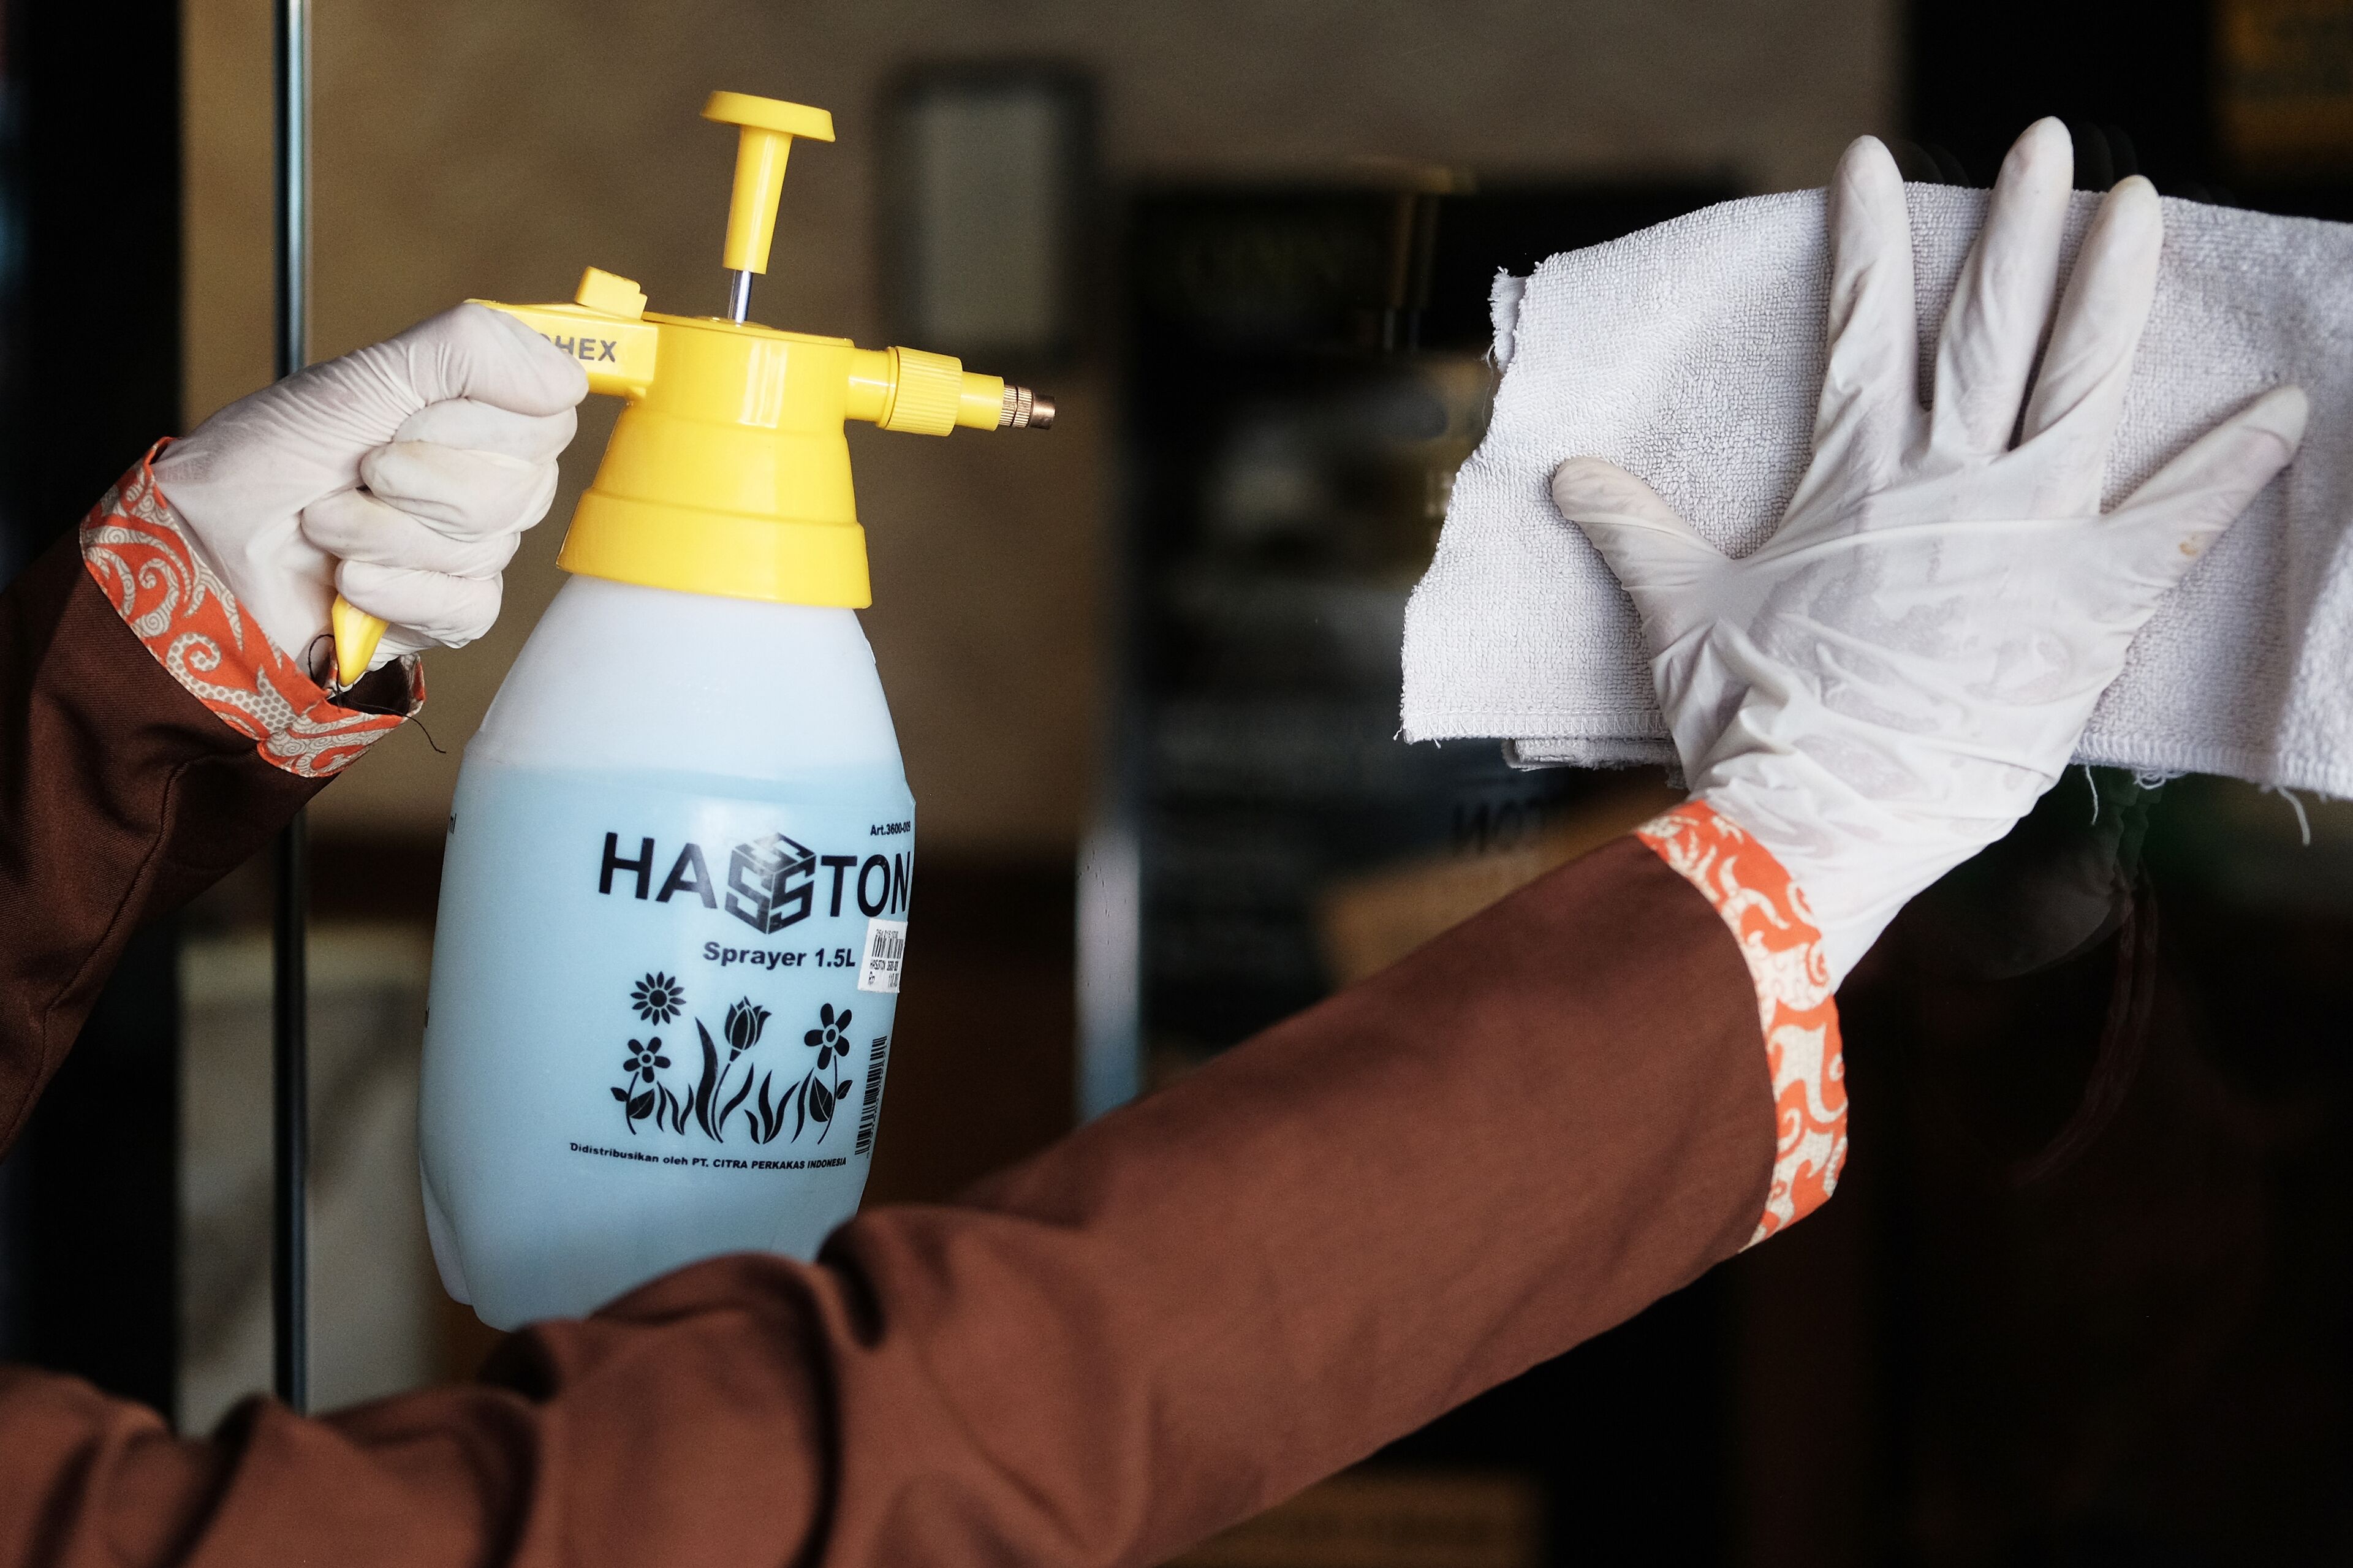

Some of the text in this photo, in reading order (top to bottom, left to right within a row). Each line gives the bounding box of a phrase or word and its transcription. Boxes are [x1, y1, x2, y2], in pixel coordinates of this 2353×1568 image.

[539, 333, 616, 363] HEX
[702, 941, 856, 971] Sprayer 1.5L
[569, 1142, 846, 1170] Didistribusikan oleh PT. CITRA PERKAKAS INDONESIA
